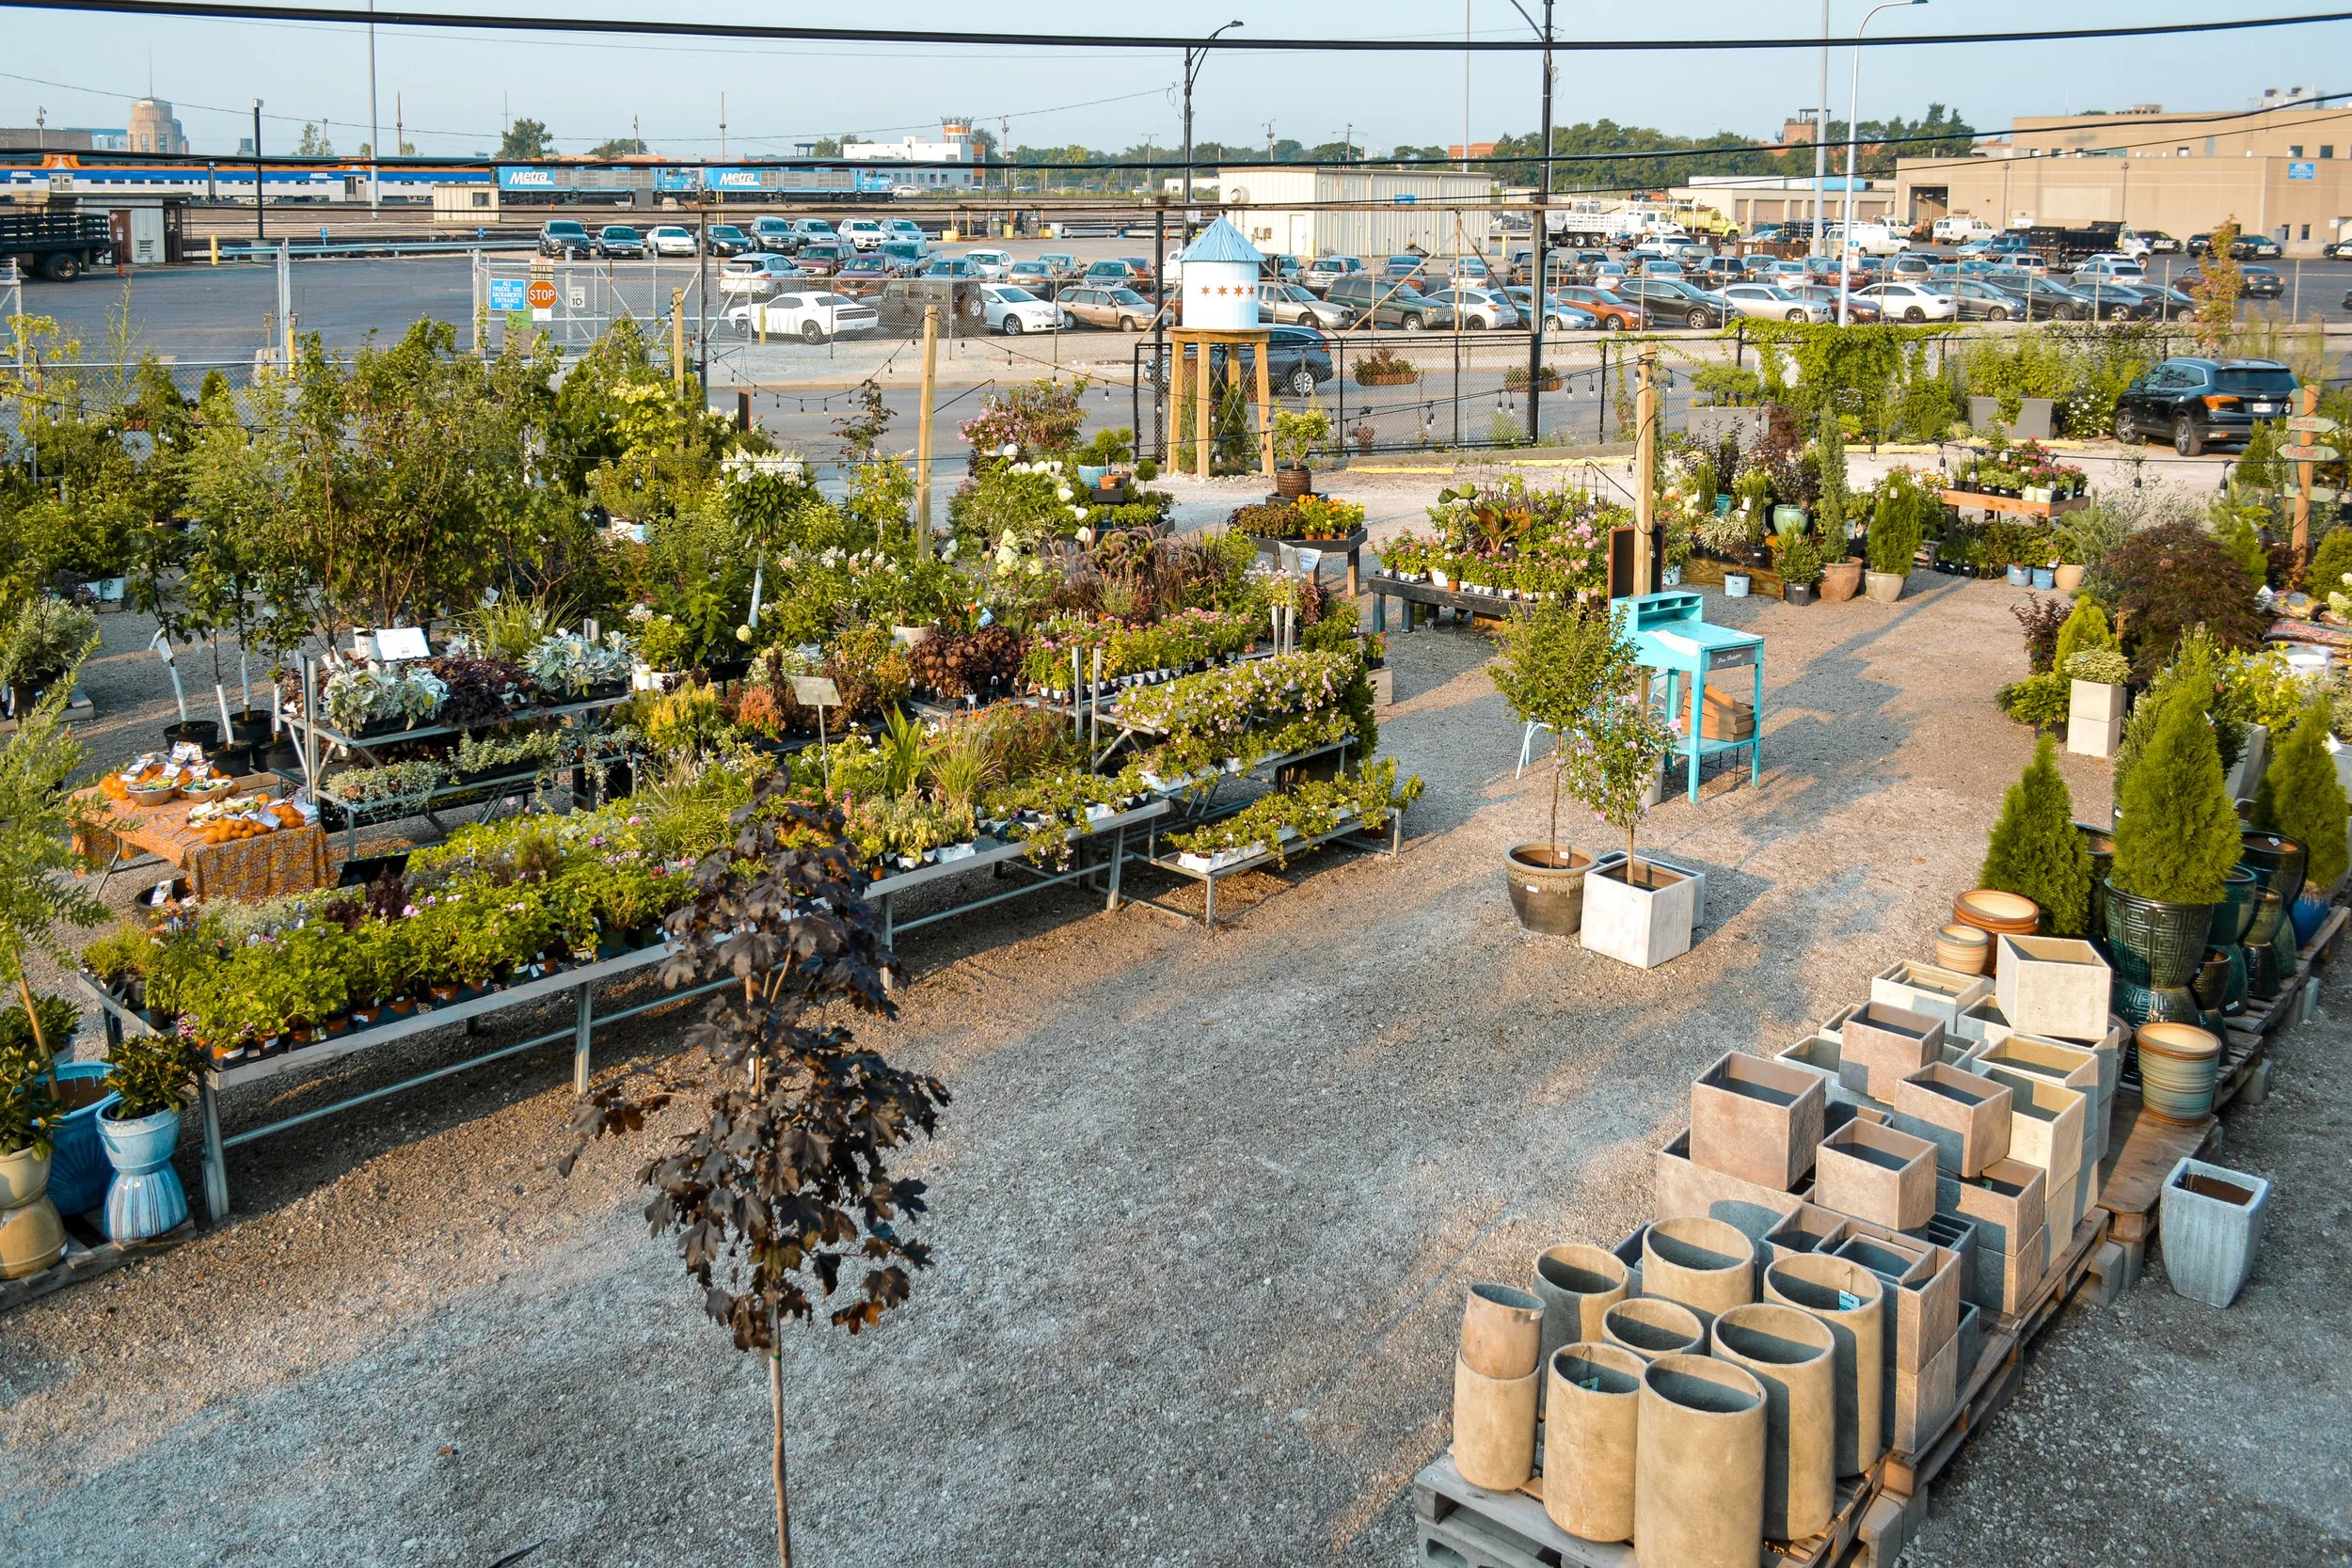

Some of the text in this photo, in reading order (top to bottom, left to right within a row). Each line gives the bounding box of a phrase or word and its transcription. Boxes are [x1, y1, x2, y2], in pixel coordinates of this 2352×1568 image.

[509, 171, 553, 184] Metra
[720, 172, 760, 185] Metra
[529, 289, 555, 301] STOP
[572, 297, 582, 306] 10
